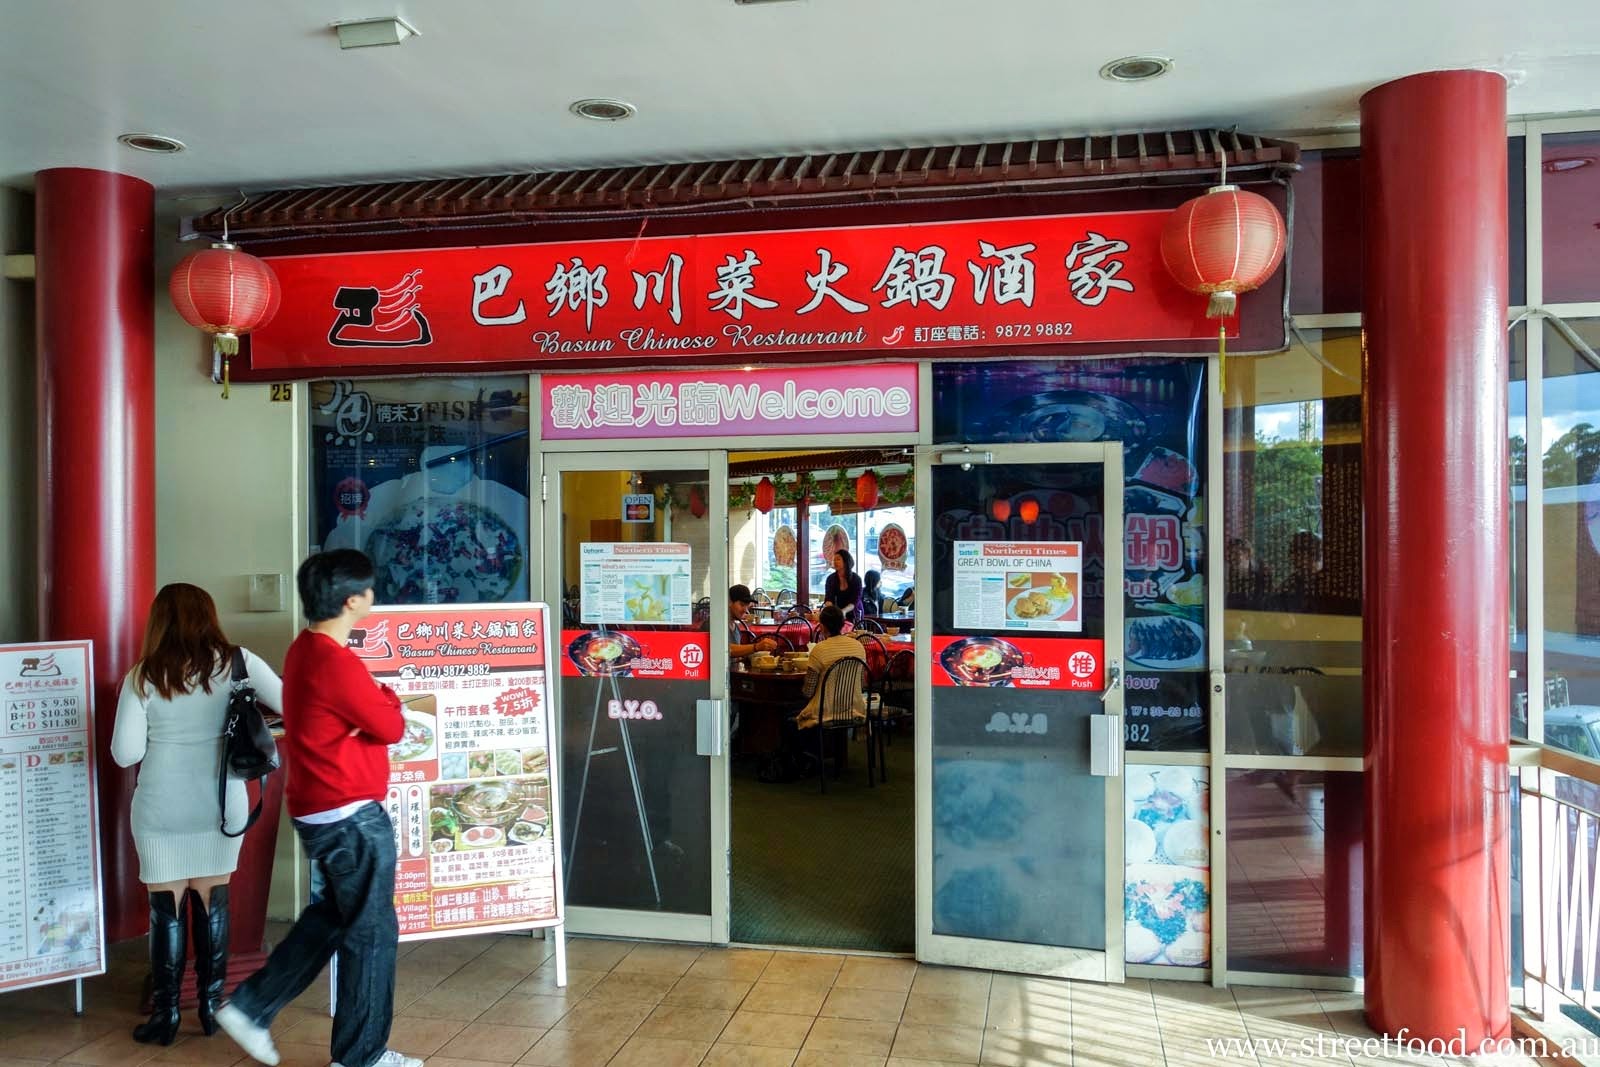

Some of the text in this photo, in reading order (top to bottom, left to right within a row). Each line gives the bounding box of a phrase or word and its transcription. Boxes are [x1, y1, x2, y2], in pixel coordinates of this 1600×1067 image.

[471, 231, 1135, 333] 巴鄉川菜火鍋酒家
[996, 324, 1032, 338] 9872
[1036, 323, 1073, 336] 9882
[533, 324, 868, 353] Basun Chinese Restaurant
[272, 384, 291, 400] 25
[551, 380, 911, 428] 歡迎光臨 Welcome
[624, 496, 653, 504] OPEN
[984, 547, 1068, 555] Northern Times
[957, 558, 1053, 568] GREAT BOWL OF CHINA
[398, 643, 537, 658] Basun Chinese Restaurant
[683, 647, 700, 664] 拉
[420, 663, 490, 679] (02) 9872 9882
[1072, 655, 1092, 674] 推
[684, 669, 699, 677] Pull
[1071, 679, 1093, 688] Push
[53, 698, 76, 707] 9.80
[501, 689, 527, 702] WOW!
[10, 708, 76, 720] B+D $10.80
[608, 699, 663, 720] B.Y.O.
[10, 719, 77, 730] C+D $11.80
[26, 754, 41, 768] D
